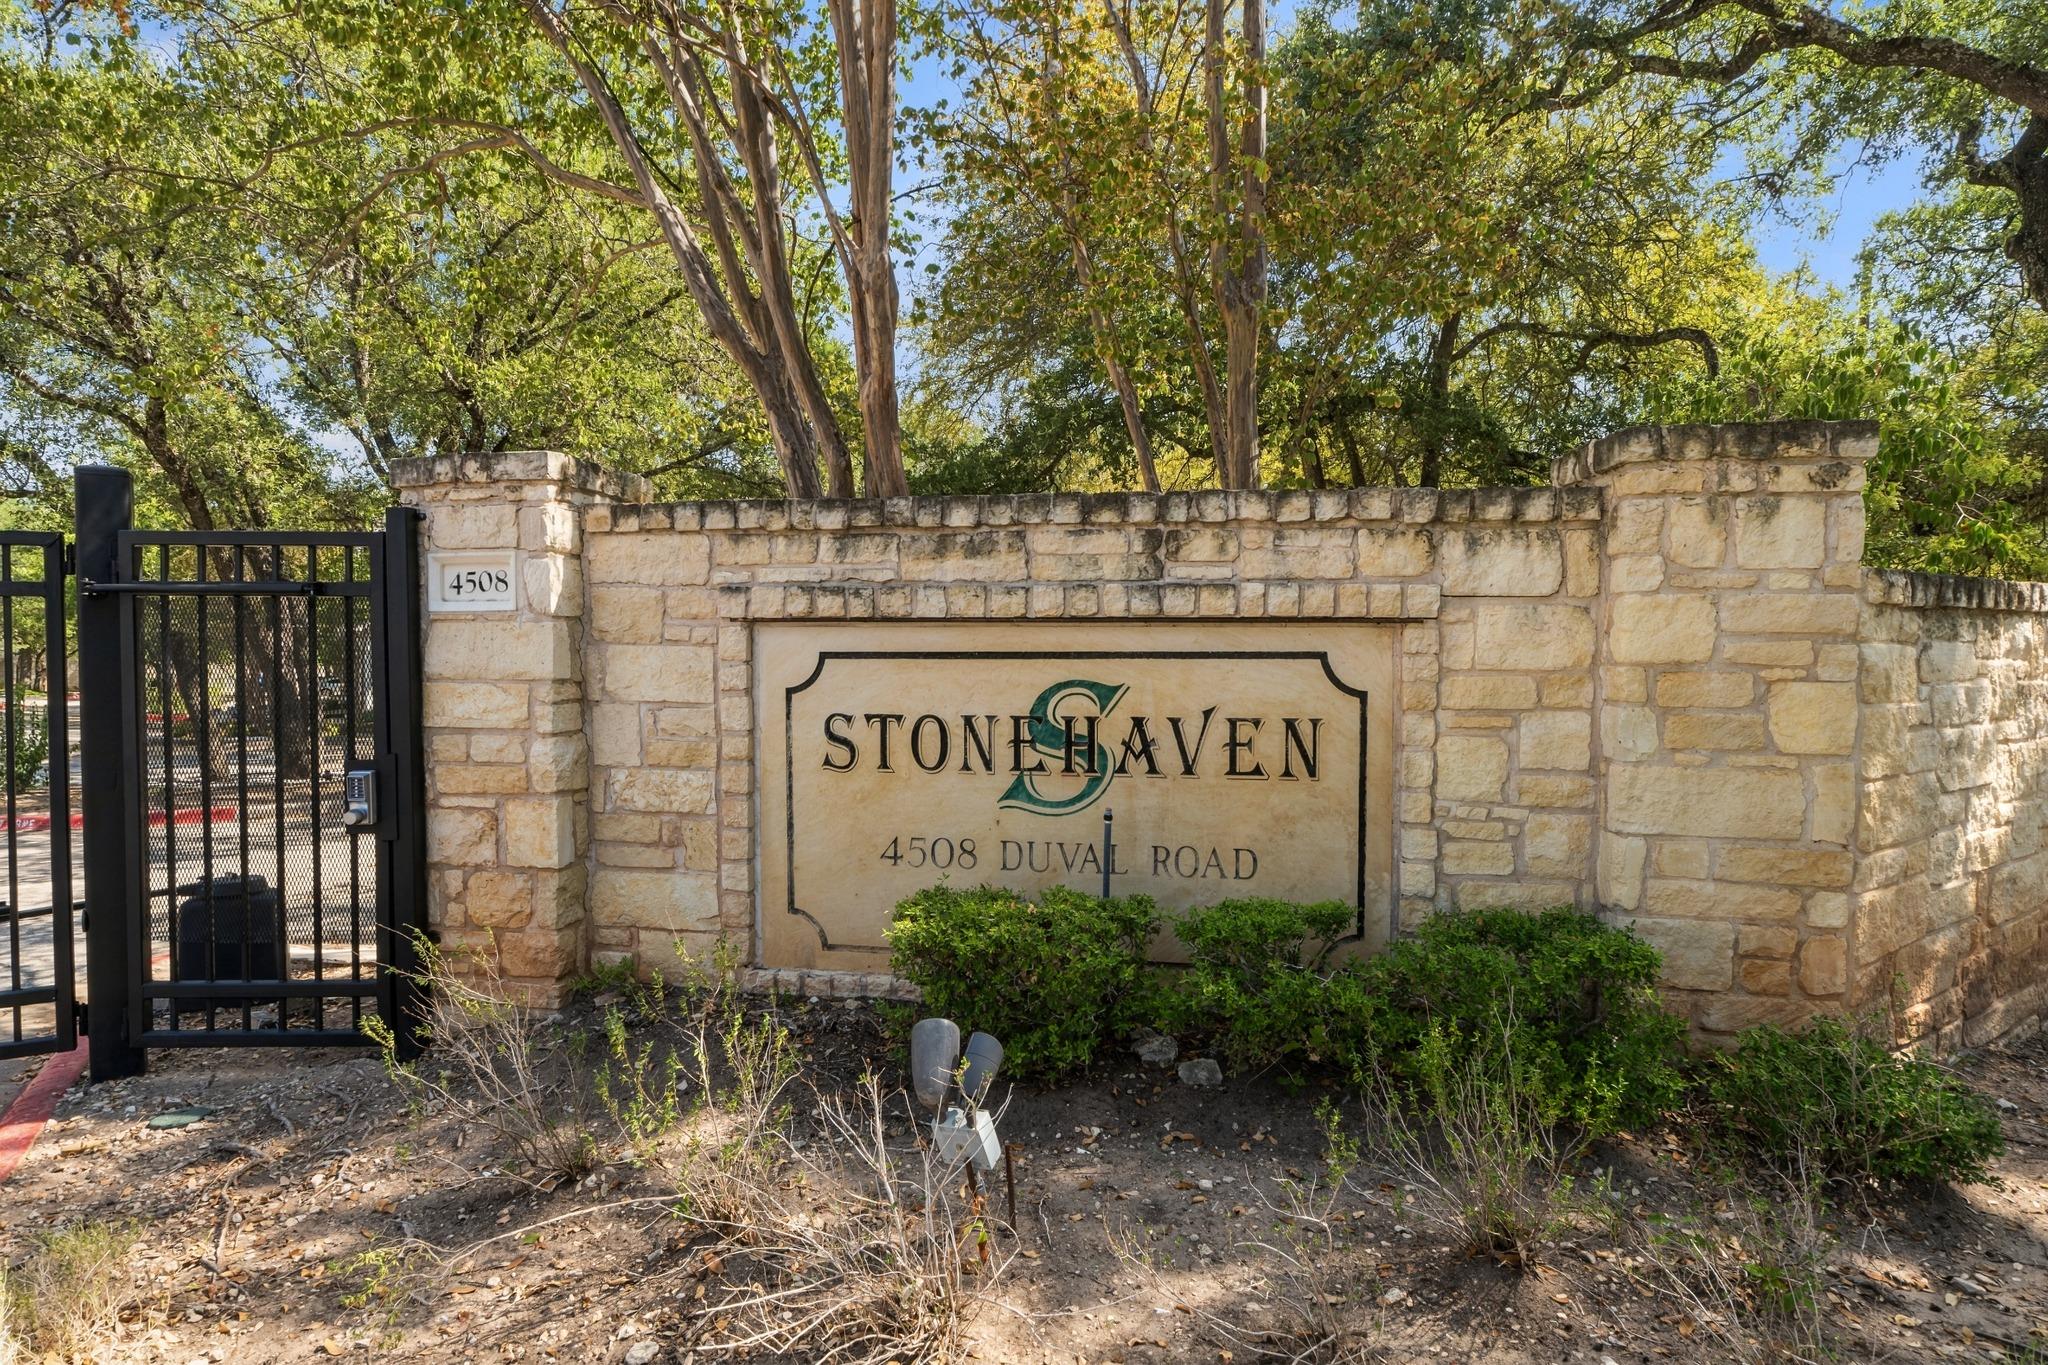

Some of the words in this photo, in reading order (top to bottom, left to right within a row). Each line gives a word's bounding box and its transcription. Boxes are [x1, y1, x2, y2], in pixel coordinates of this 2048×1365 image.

[449, 569, 509, 595] 4508
[822, 705, 1325, 781] STONEHAVEN
[880, 835, 978, 869] 4508
[999, 839, 1128, 876] DUVAL
[1152, 846, 1259, 880] ROAD
